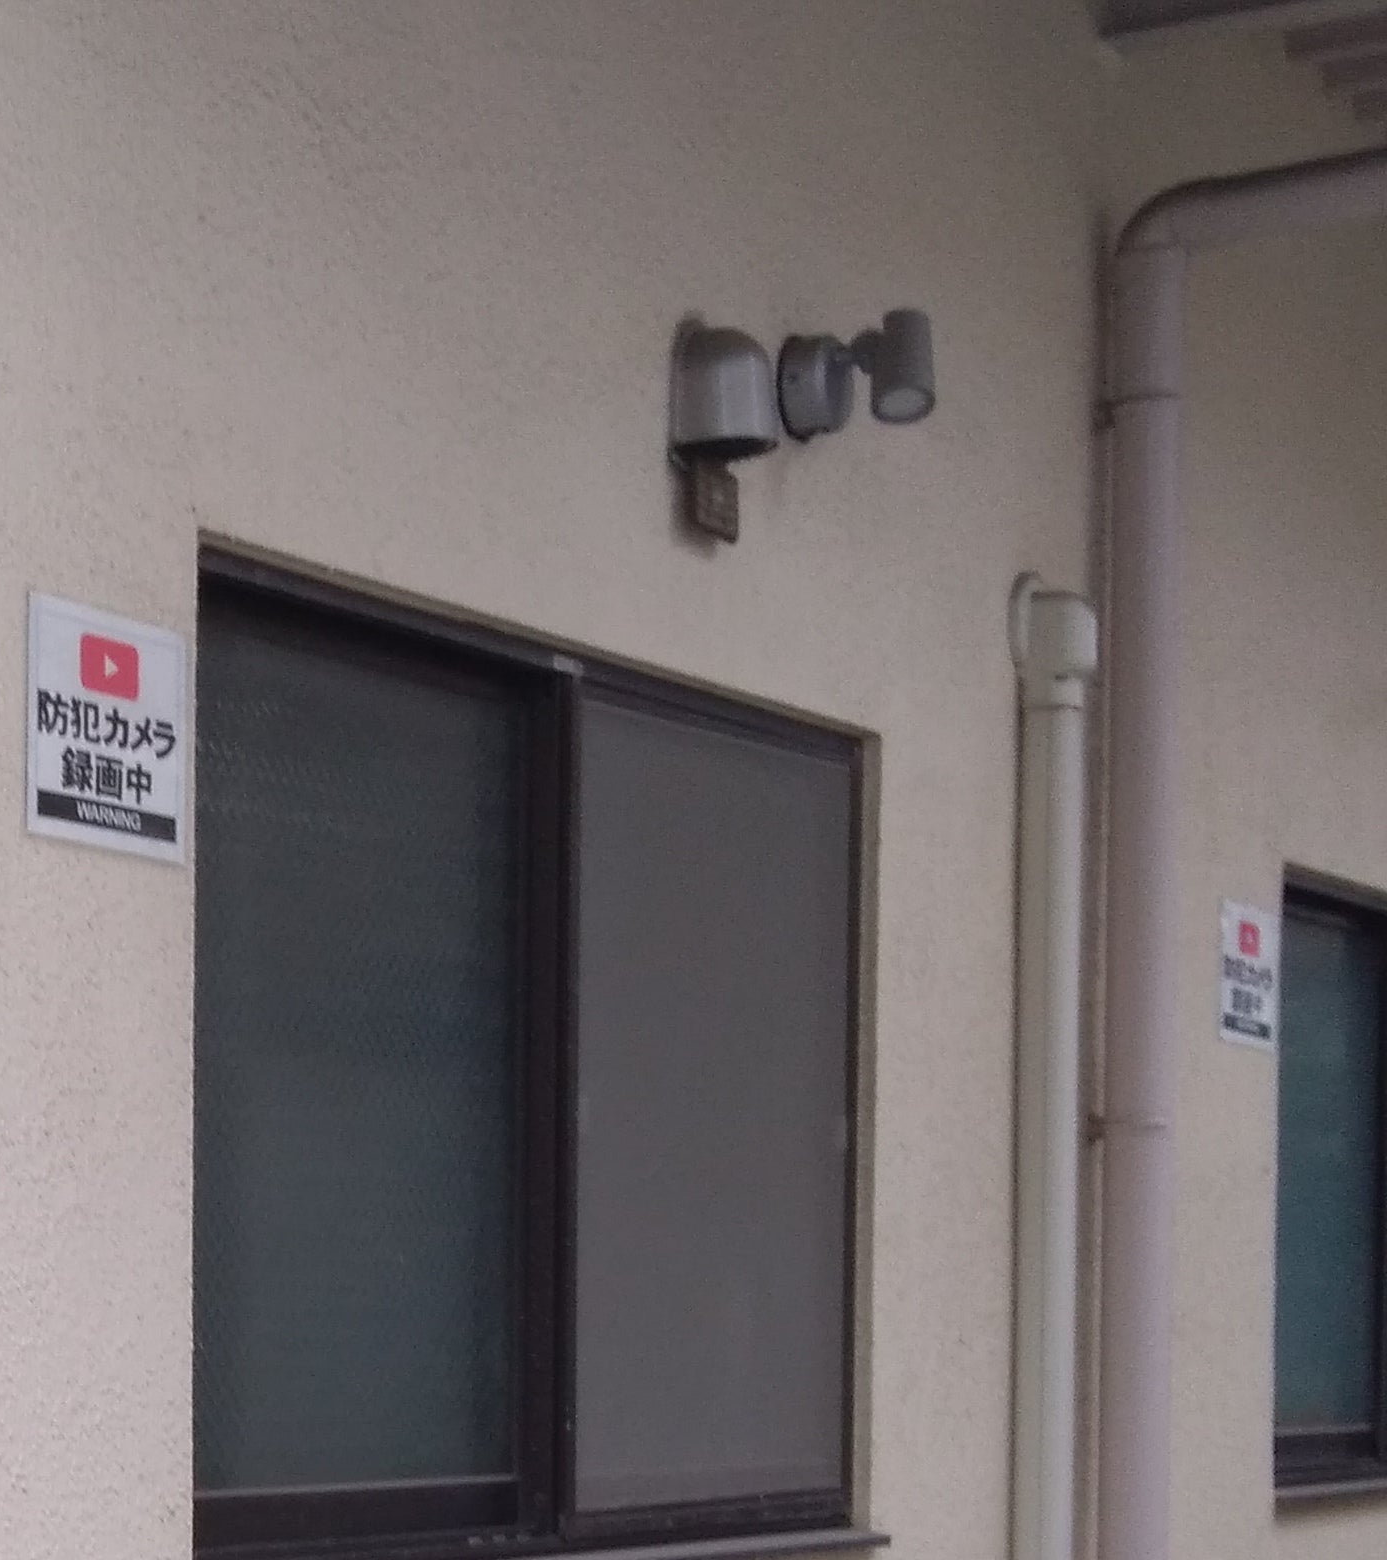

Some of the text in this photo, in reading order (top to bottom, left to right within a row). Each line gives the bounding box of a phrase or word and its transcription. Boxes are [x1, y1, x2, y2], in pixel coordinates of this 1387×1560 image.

[36, 687, 177, 760] 防犯カメラ
[60, 745, 153, 805] 録画中
[77, 799, 142, 832] WARNING
